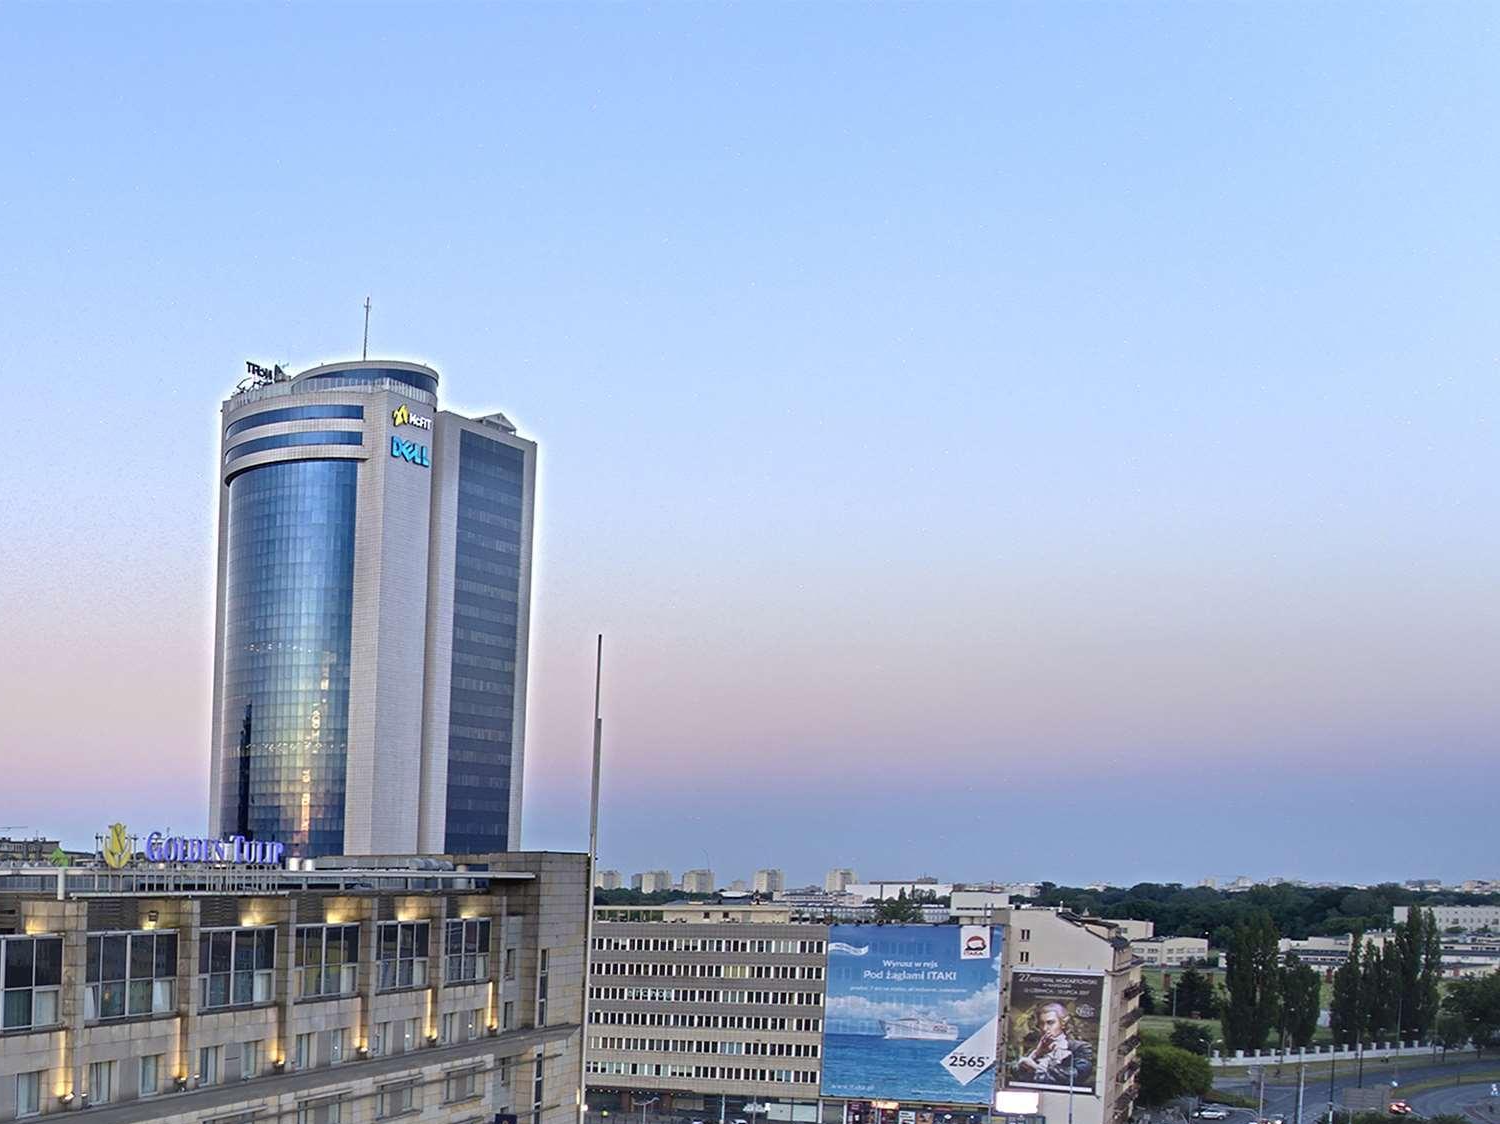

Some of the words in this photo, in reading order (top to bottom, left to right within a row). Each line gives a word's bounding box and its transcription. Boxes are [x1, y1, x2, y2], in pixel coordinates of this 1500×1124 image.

[391, 436, 429, 468] DELL
[146, 831, 227, 863] GOLDEN
[229, 835, 284, 864] TULIP
[863, 970, 883, 980] Pod
[926, 971, 956, 980] ITAKI
